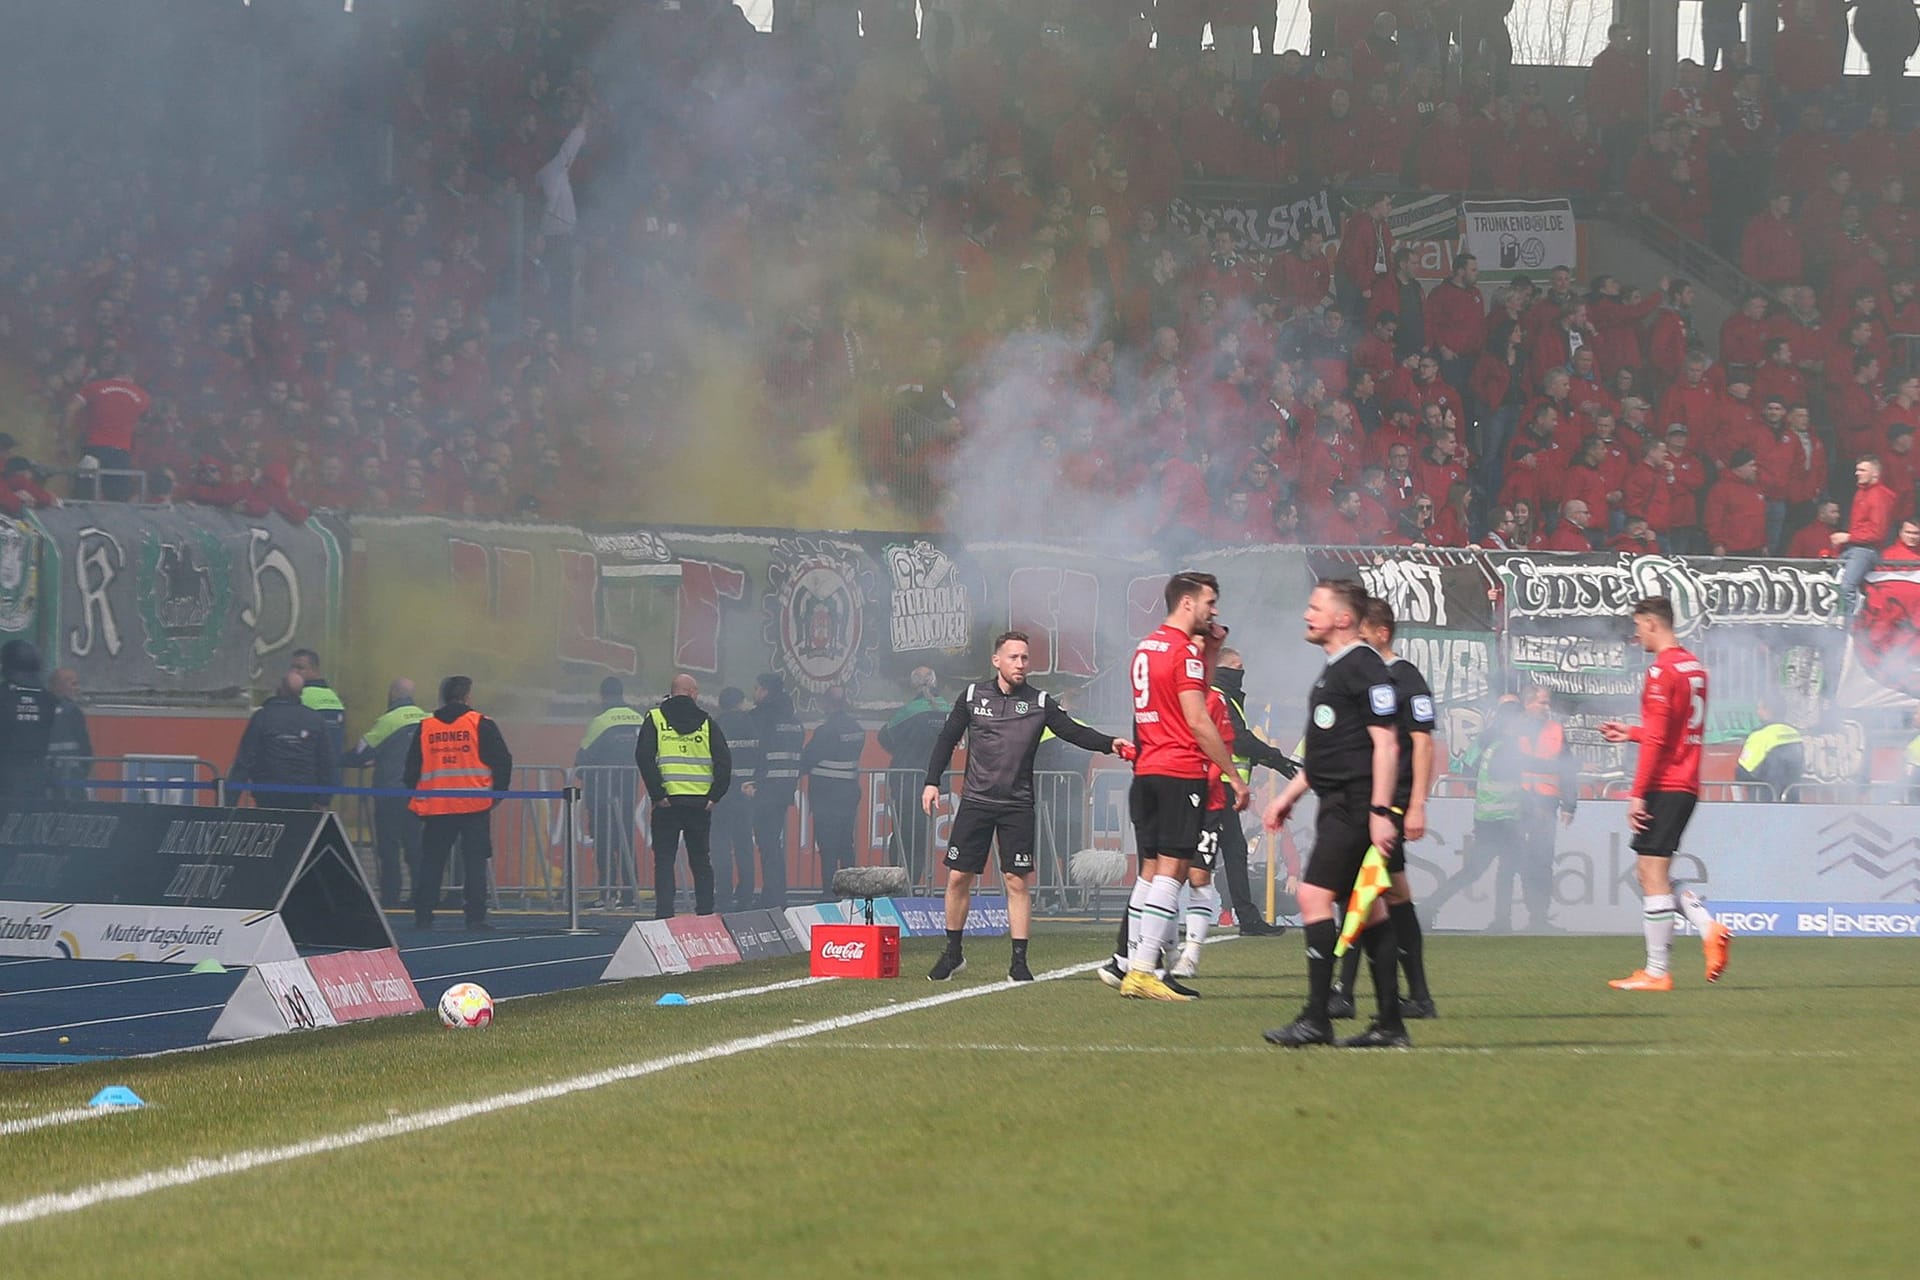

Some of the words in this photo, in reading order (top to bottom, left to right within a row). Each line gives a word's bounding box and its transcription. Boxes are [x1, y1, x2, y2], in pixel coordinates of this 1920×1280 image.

[1132, 652, 1150, 708] 9
[1687, 676, 1705, 729] 5
[428, 730, 471, 744] ORDNER
[101, 923, 224, 950] Muttertagsbuffet
[821, 940, 866, 960] Coca-Cola
